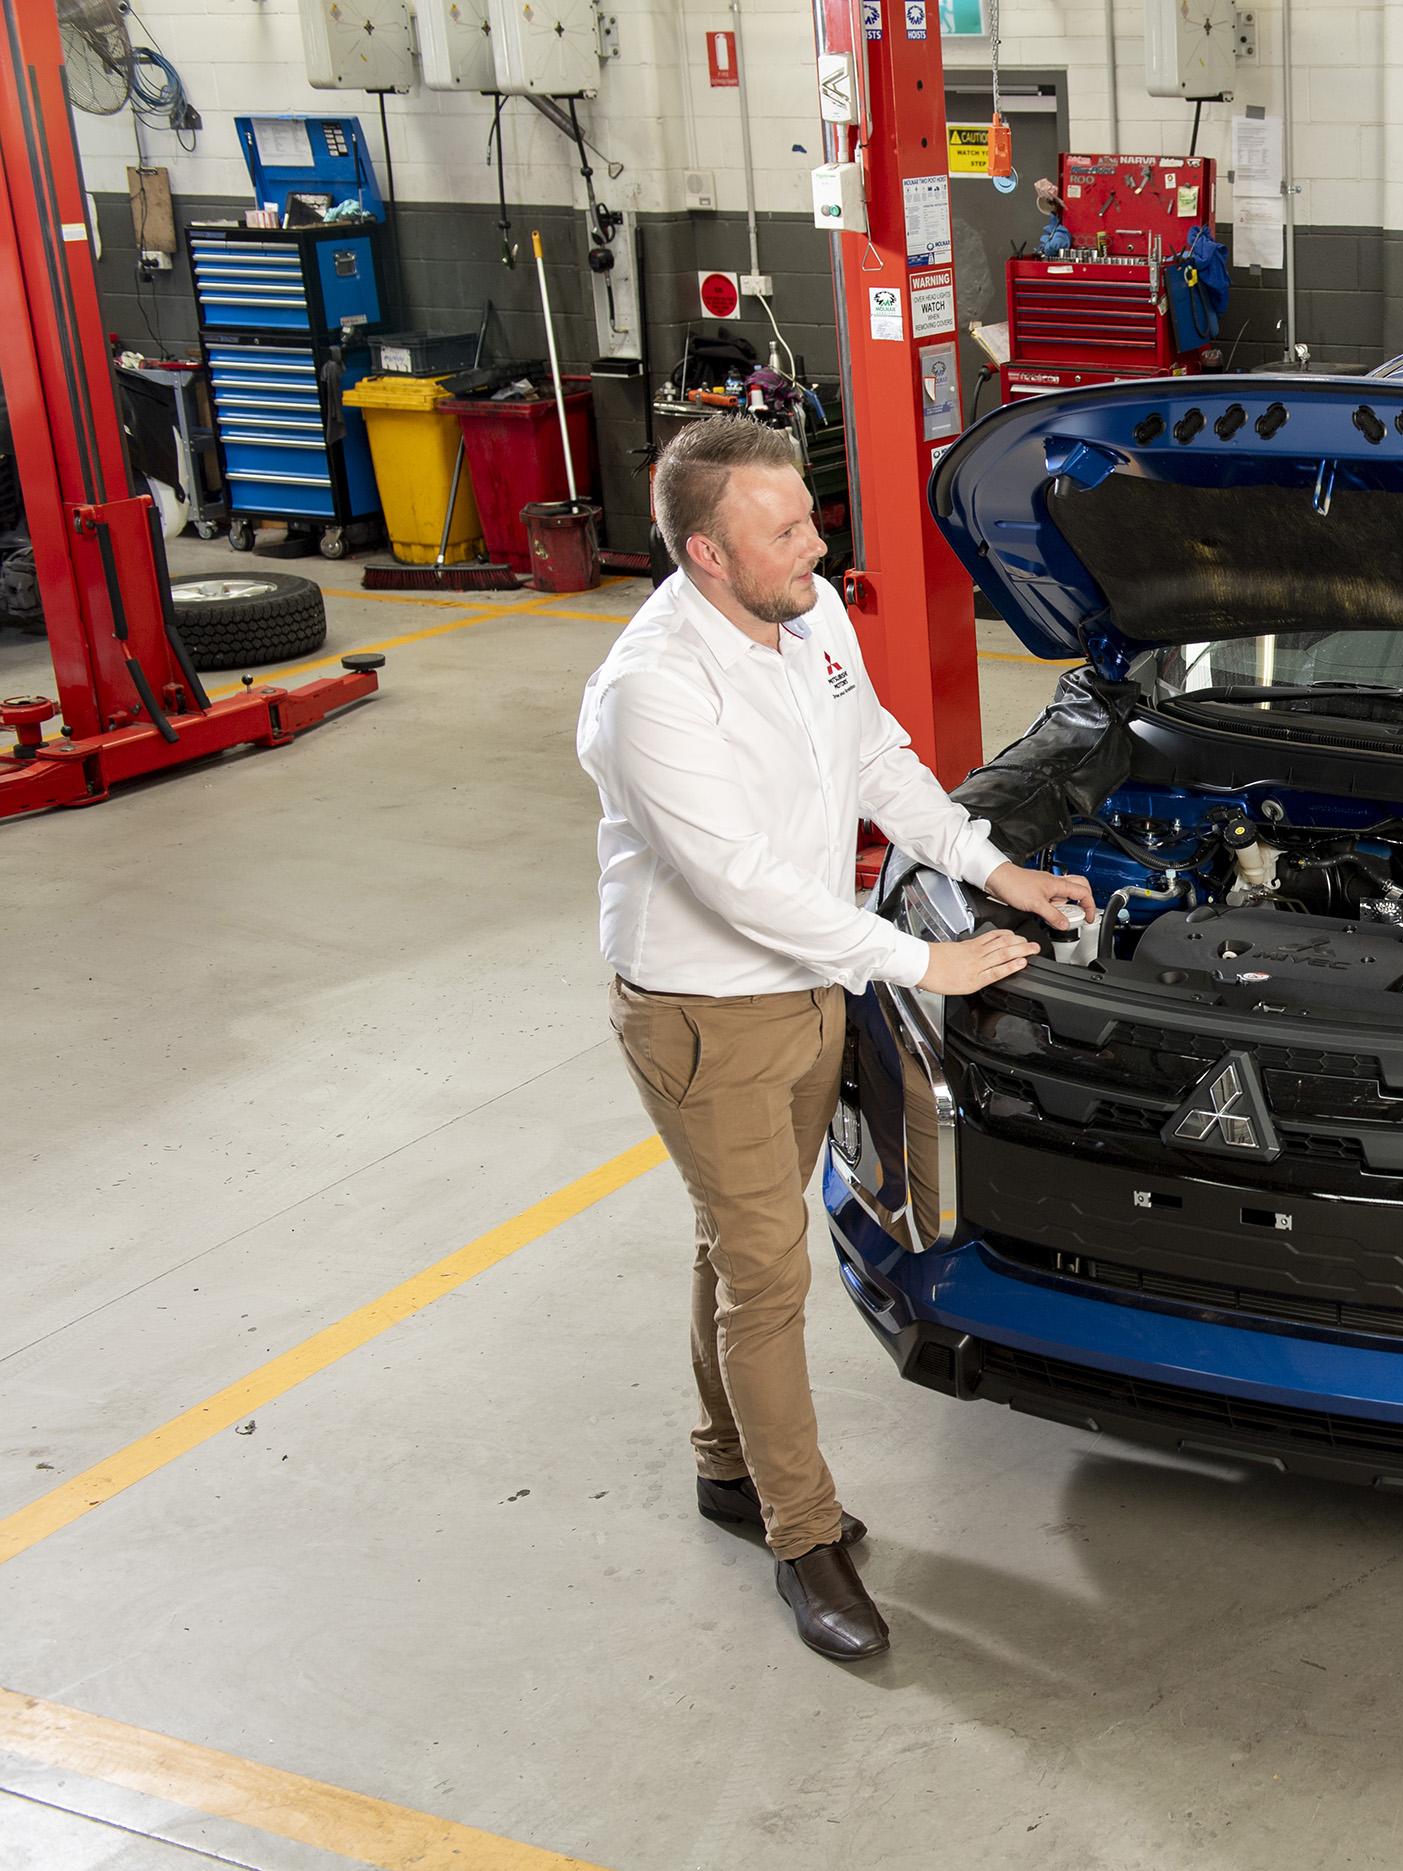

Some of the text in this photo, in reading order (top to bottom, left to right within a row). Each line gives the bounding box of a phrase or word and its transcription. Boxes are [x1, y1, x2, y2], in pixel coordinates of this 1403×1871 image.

[907, 30, 927, 39] HOISTS
[961, 131, 988, 144] CAUTIO
[1120, 156, 1156, 165] NARVA
[1070, 175, 1095, 184] ROO
[912, 273, 950, 289] WARNING
[937, 291, 951, 300] LIGHTS
[921, 301, 946, 314] WATCH
[915, 319, 953, 331] REMOVING COVERS
[1252, 952, 1352, 970] MIVEC
